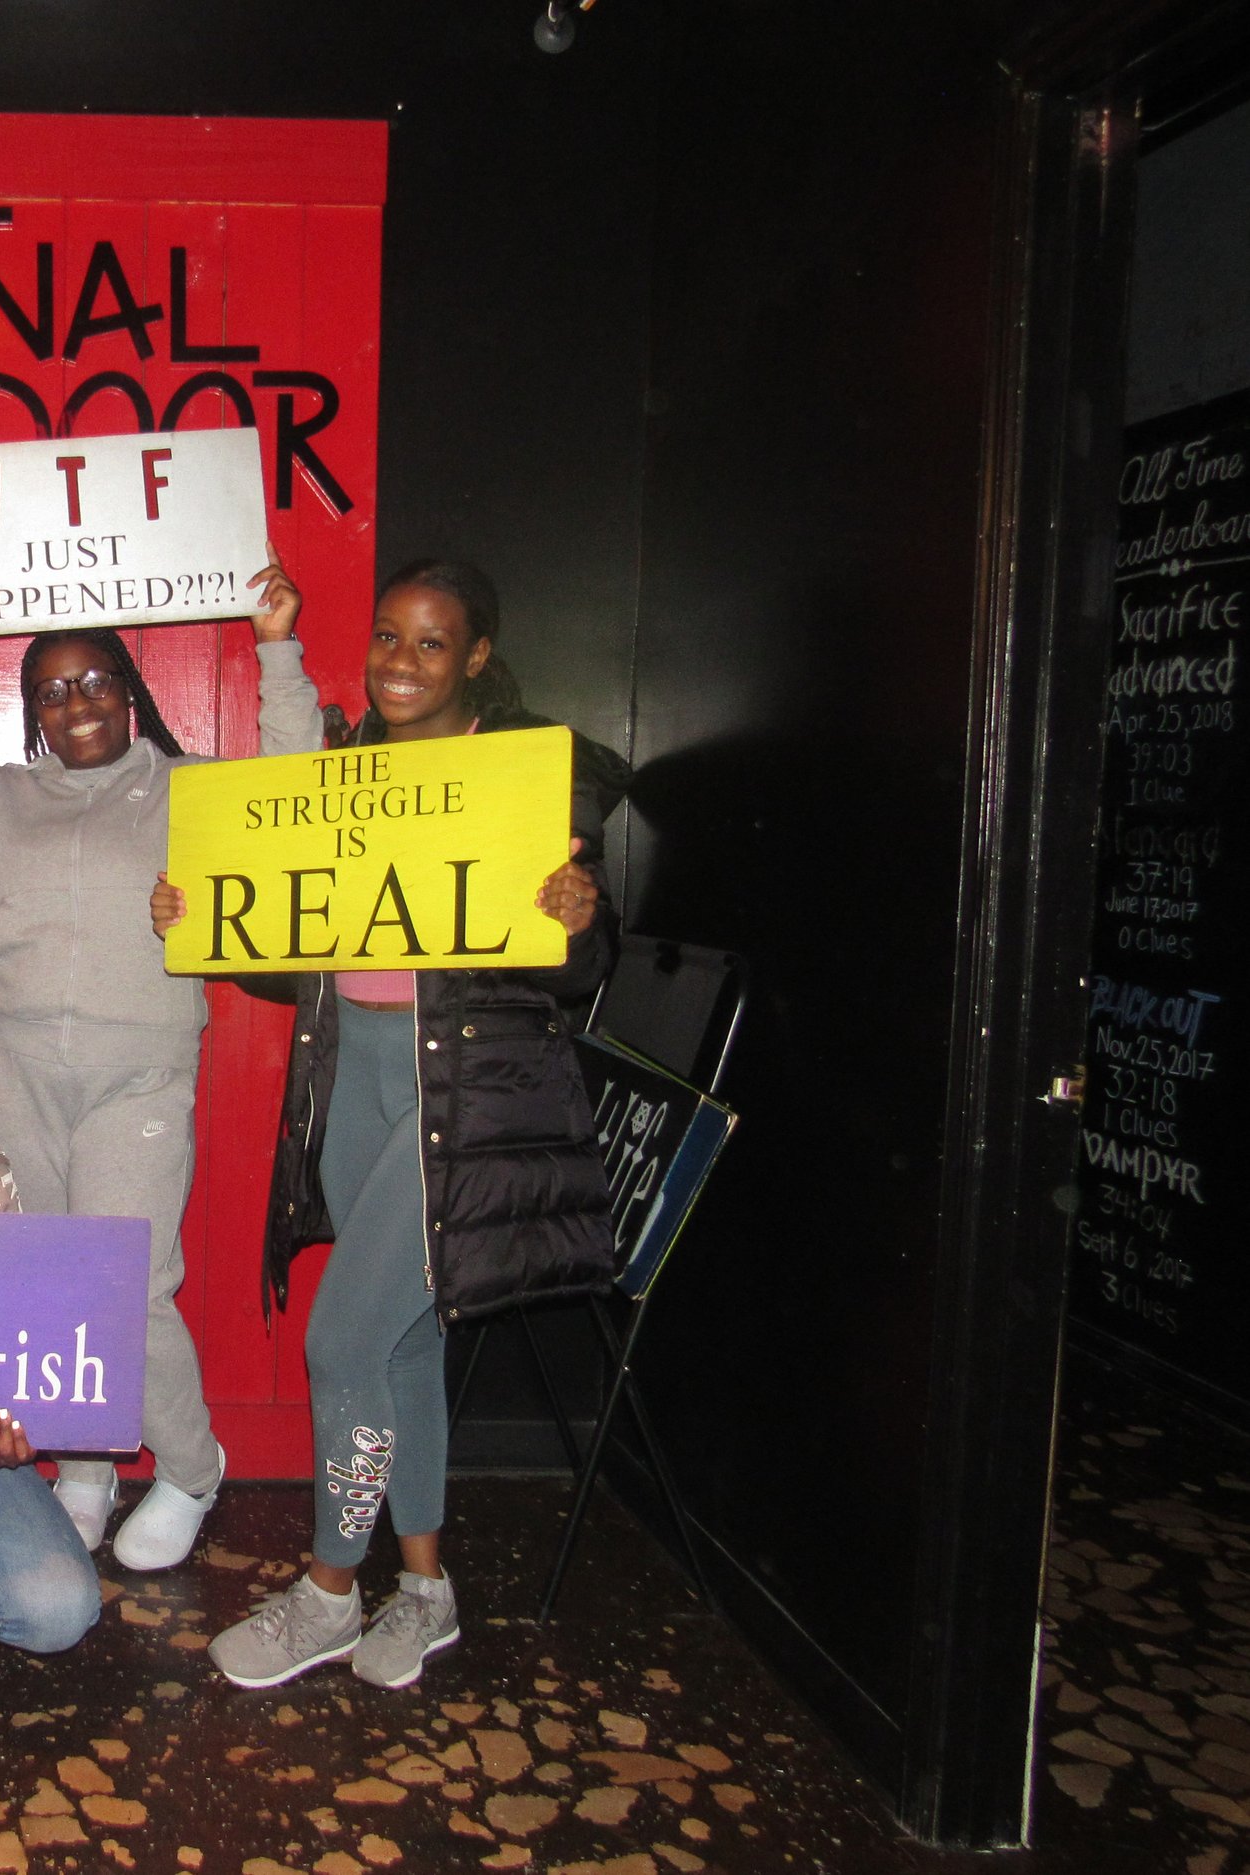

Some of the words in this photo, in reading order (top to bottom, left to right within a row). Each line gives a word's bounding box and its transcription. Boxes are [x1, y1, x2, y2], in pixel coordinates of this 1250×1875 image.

[1118, 447, 1171, 505] All
[1175, 434, 1245, 491] Time
[21, 534, 127, 573] JUST
[1115, 499, 1250, 568] eaderboar
[312, 750, 391, 788] THE
[245, 781, 465, 831] STRUGGLE
[334, 825, 367, 859] IS
[1126, 861, 1195, 898] 37:19
[203, 858, 512, 962] REAL
[1104, 1064, 1177, 1116] 32:18
[326, 1426, 395, 1539] nike
